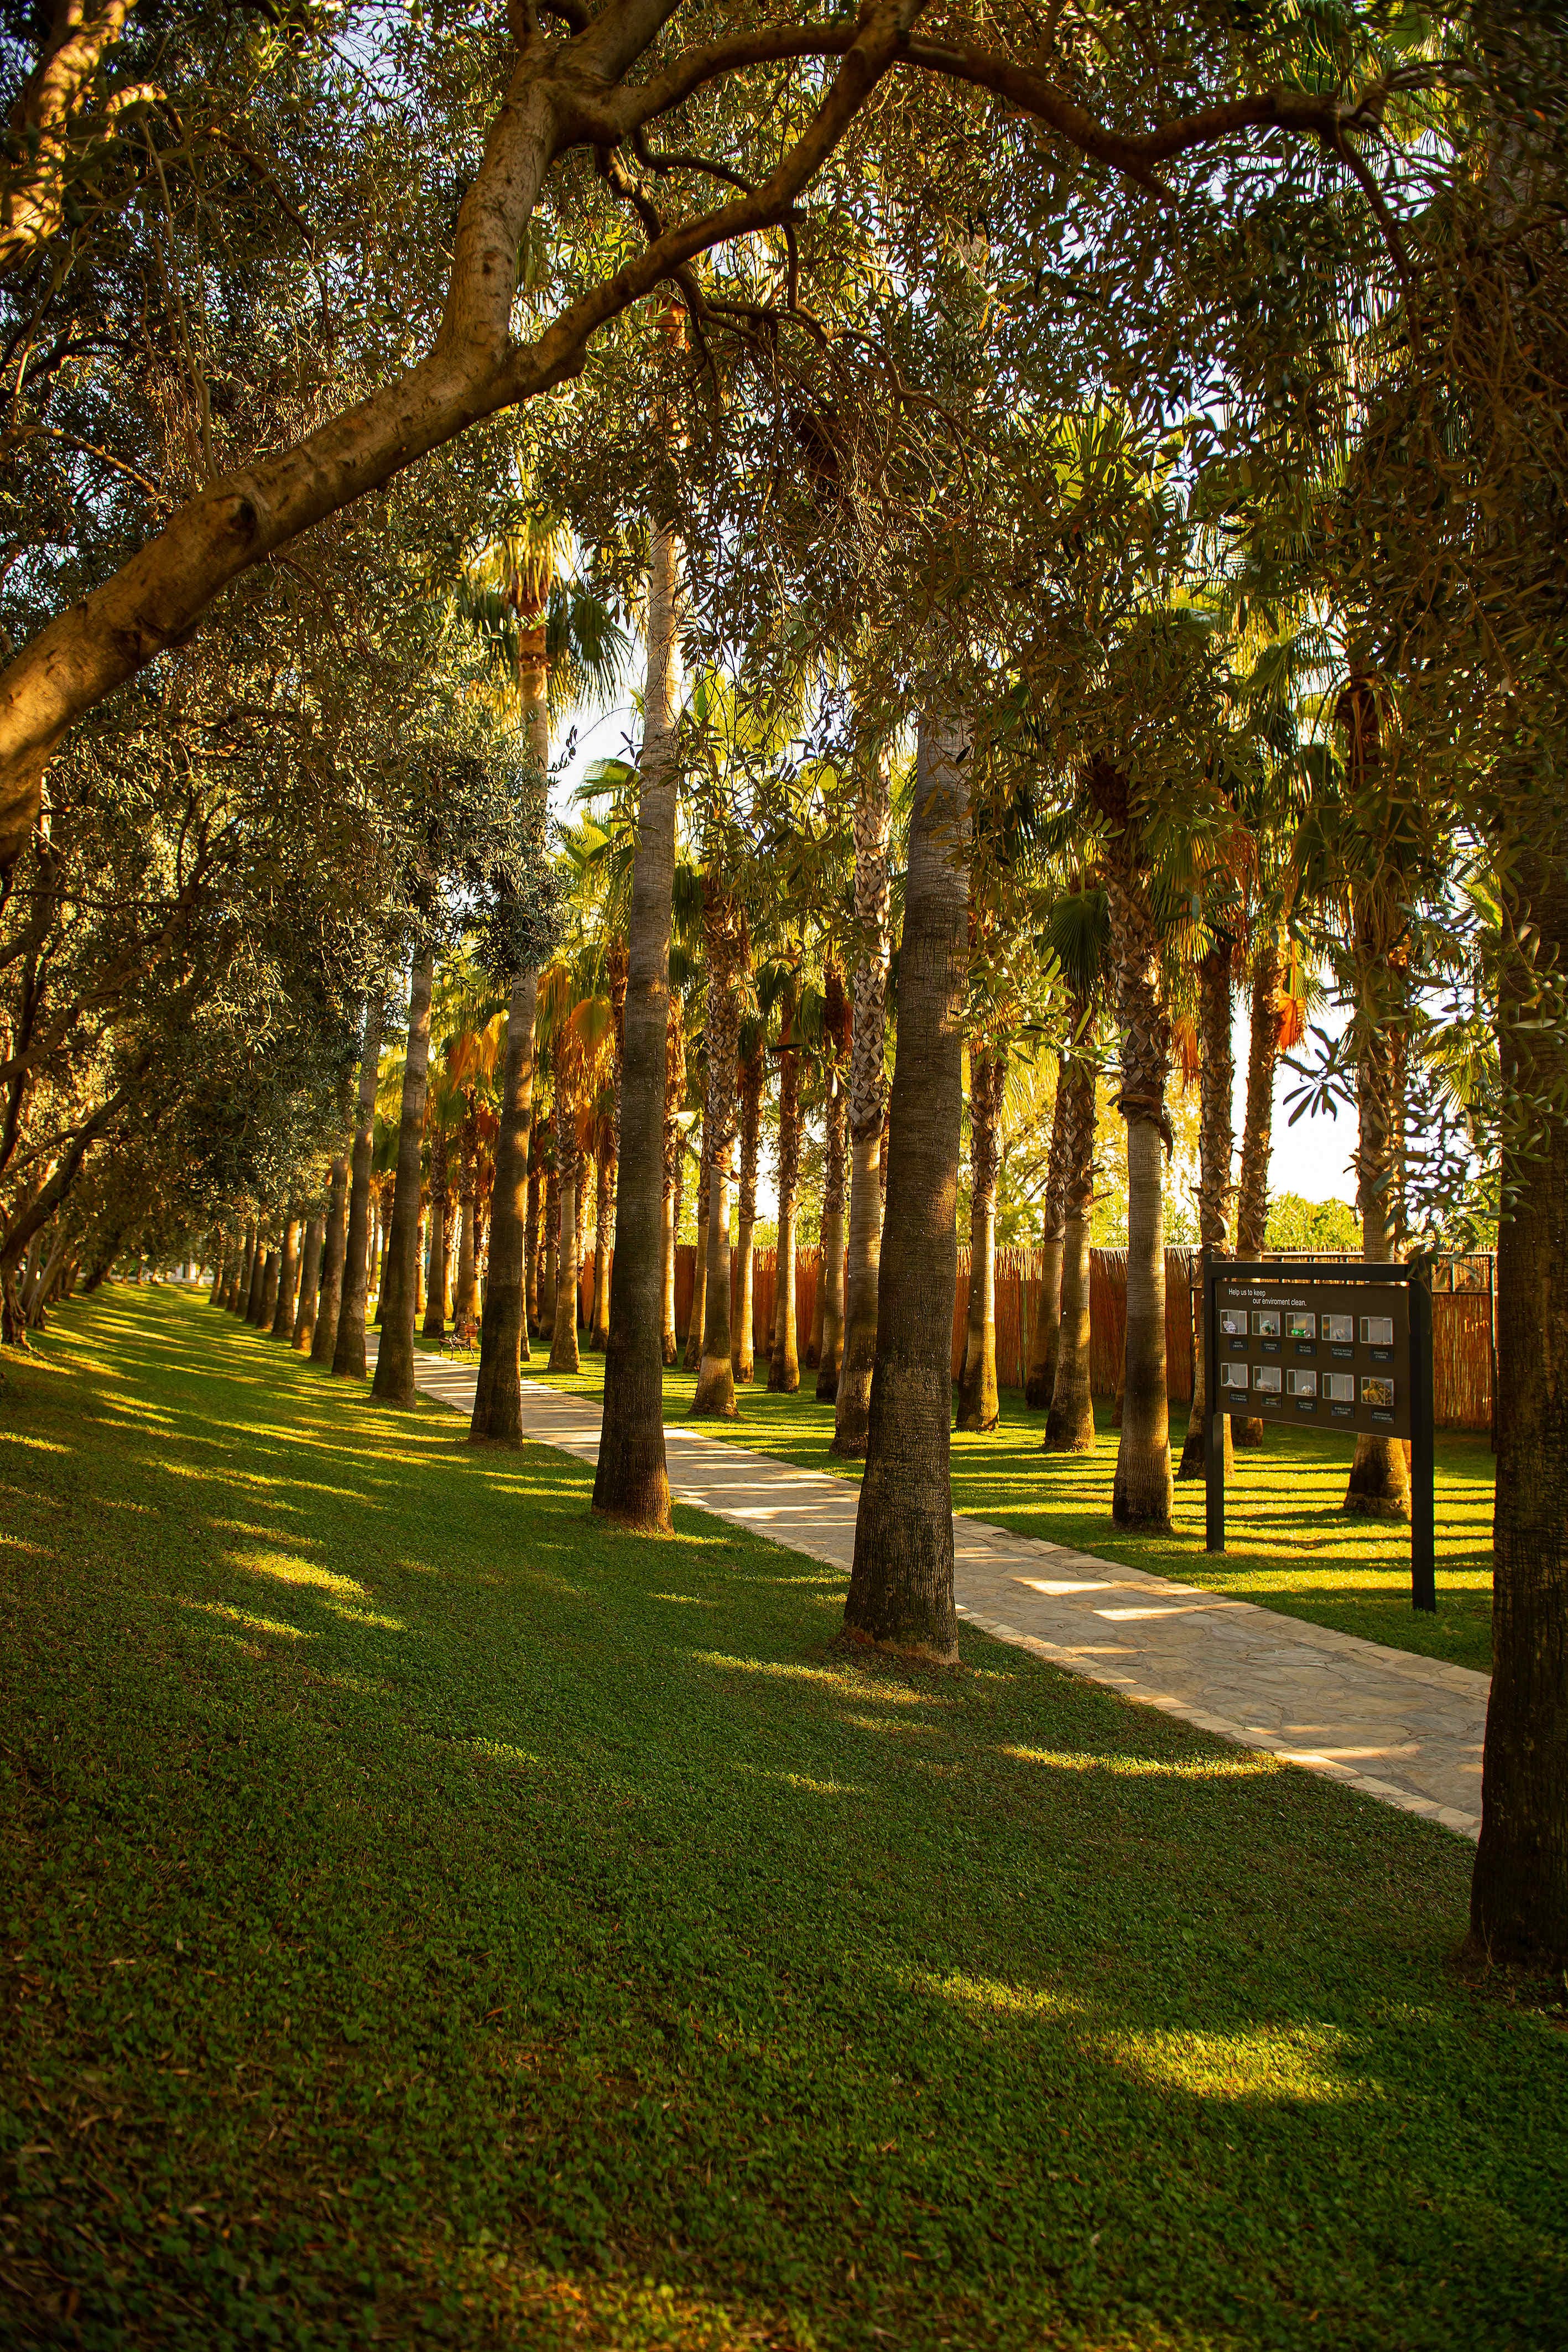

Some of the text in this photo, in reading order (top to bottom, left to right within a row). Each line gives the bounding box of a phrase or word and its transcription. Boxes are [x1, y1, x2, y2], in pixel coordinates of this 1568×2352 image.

[1228, 1288, 1239, 1297] Help
[1253, 1288, 1266, 1298] keep
[1291, 1298, 1307, 1307] clean.
